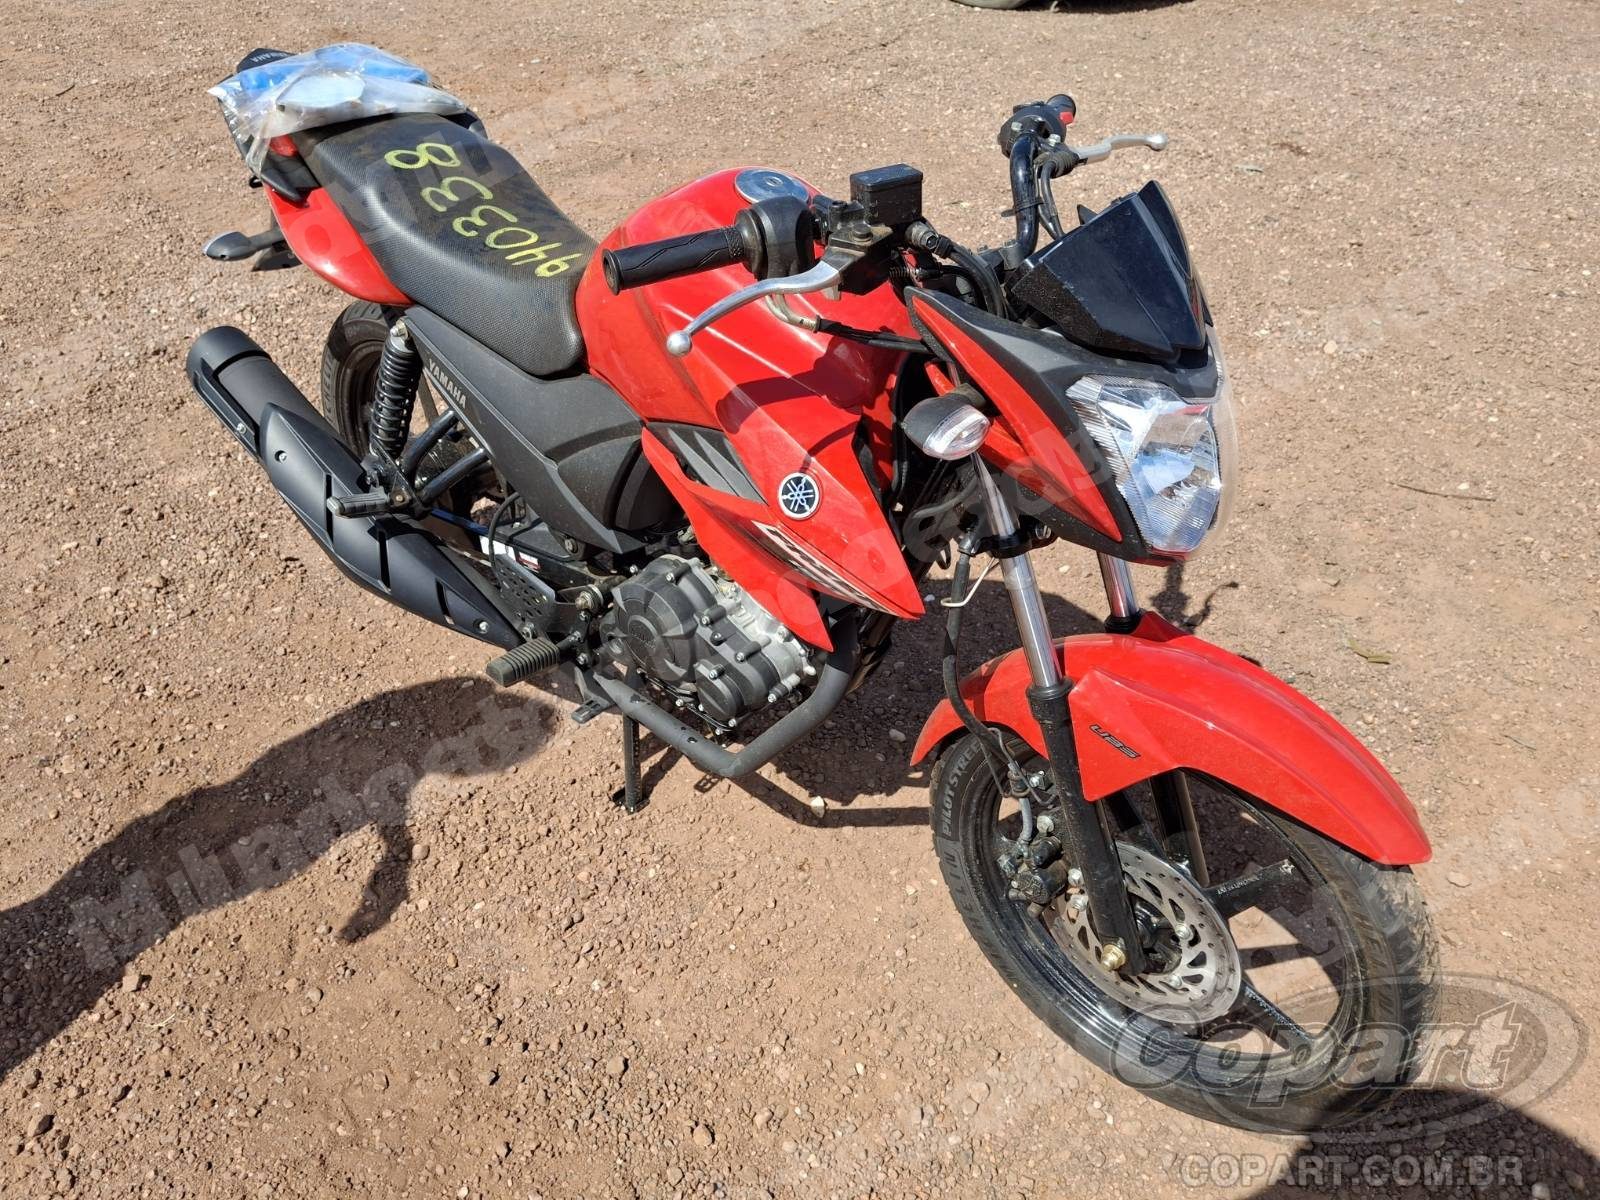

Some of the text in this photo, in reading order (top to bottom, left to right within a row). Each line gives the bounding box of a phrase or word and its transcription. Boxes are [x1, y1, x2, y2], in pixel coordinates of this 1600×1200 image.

[384, 141, 583, 278] 940338
[427, 358, 467, 410] YAMAHA
[1088, 724, 1141, 759] UBS
[941, 737, 981, 836] PILOT STREE
